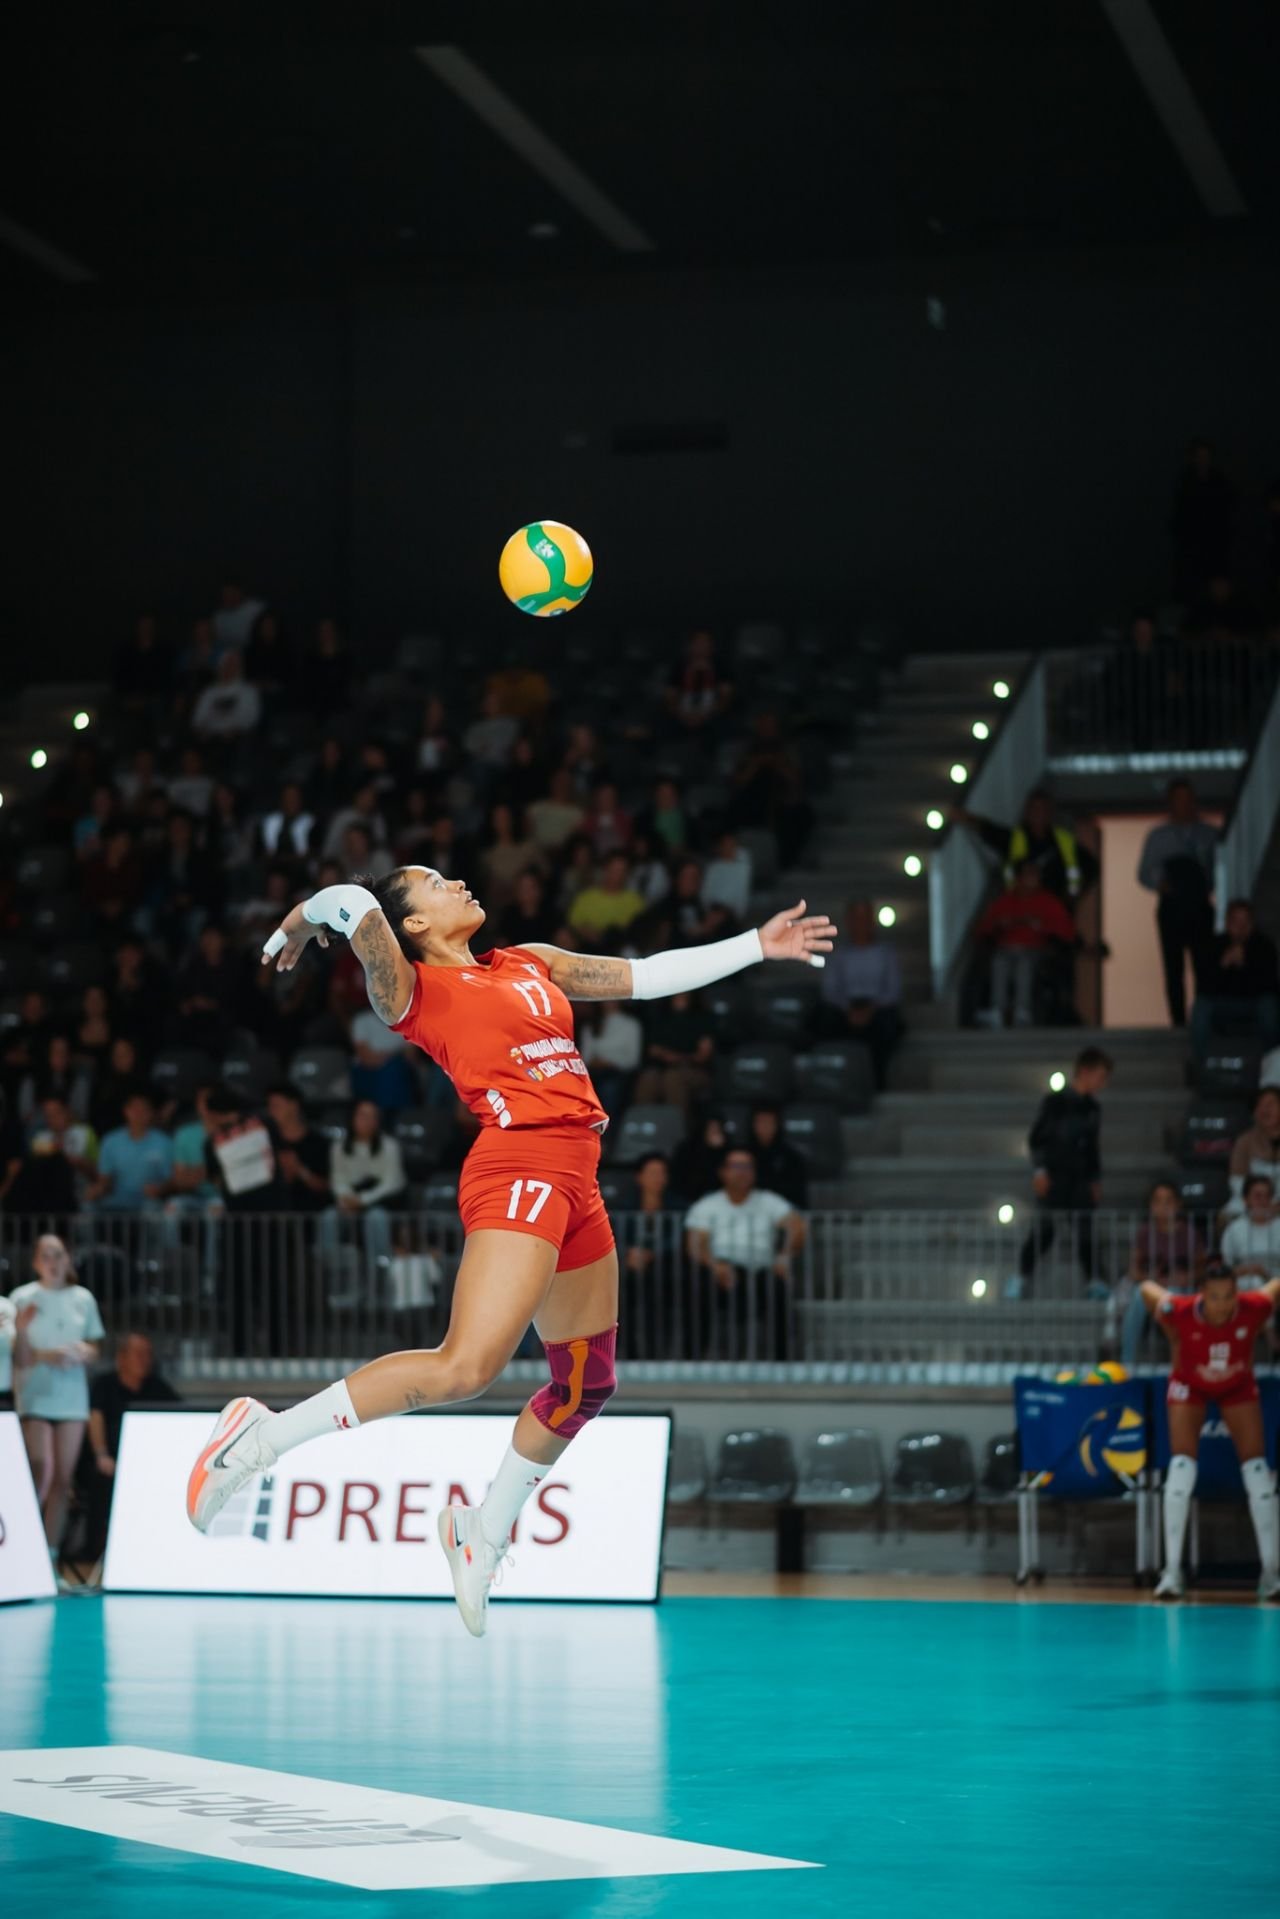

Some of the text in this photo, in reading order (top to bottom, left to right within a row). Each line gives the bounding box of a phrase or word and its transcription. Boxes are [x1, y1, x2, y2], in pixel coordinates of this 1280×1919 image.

[512, 980, 552, 1017] 17
[507, 1179, 553, 1223] 17
[286, 1481, 571, 1545] PRES
[13, 1774, 385, 1828] PRENIS
